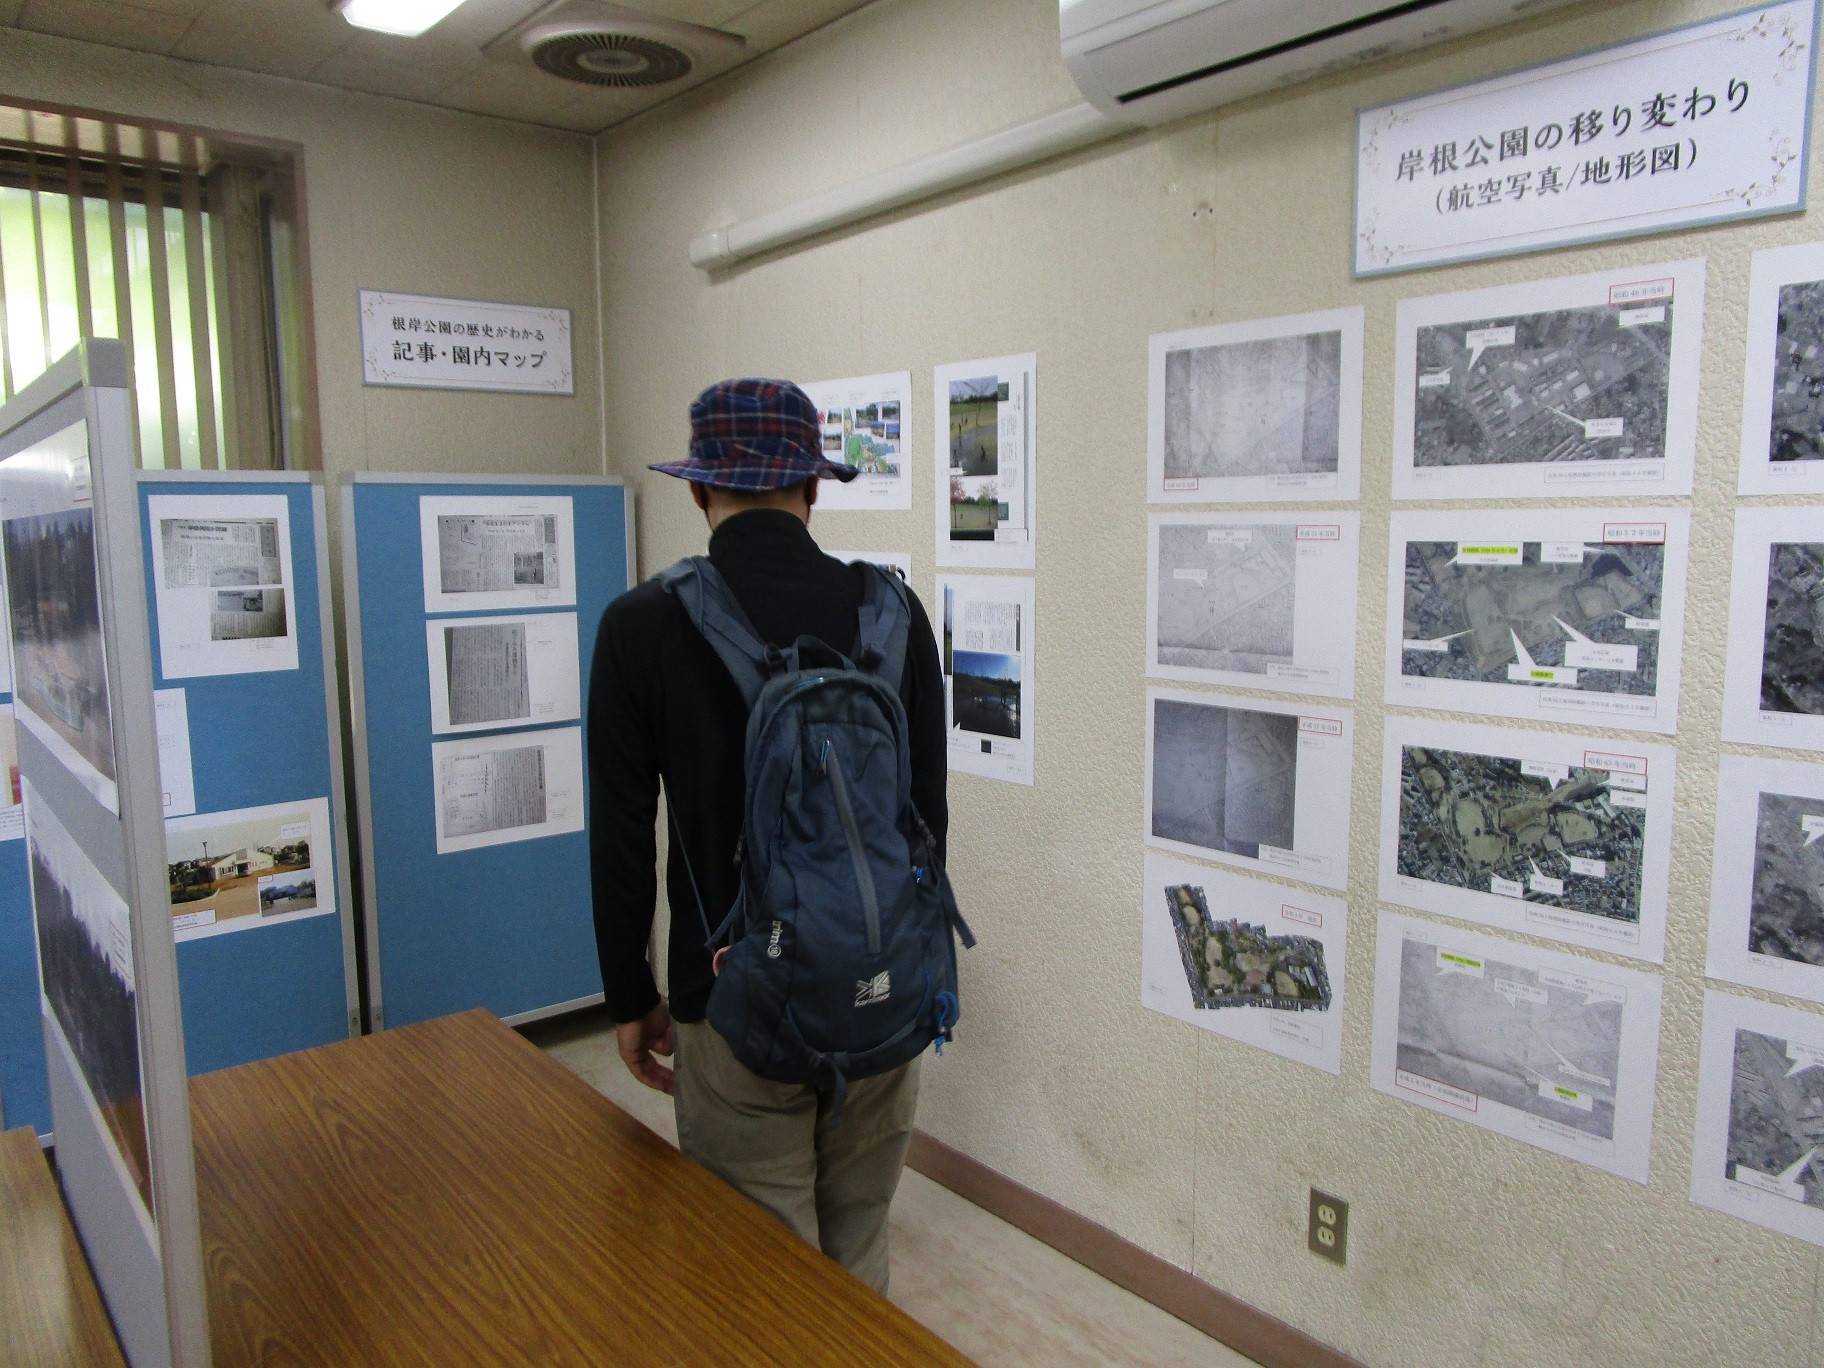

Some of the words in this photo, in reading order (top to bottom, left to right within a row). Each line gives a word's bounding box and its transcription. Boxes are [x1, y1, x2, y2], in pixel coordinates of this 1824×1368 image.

[1395, 76, 1751, 183] 岸根公園の移り変わり
[1434, 137, 1698, 216] （航空写真/地形図）
[391, 315, 545, 342] 根岸公園の歴史がわかる
[391, 339, 548, 369] 記事・園内マップ
